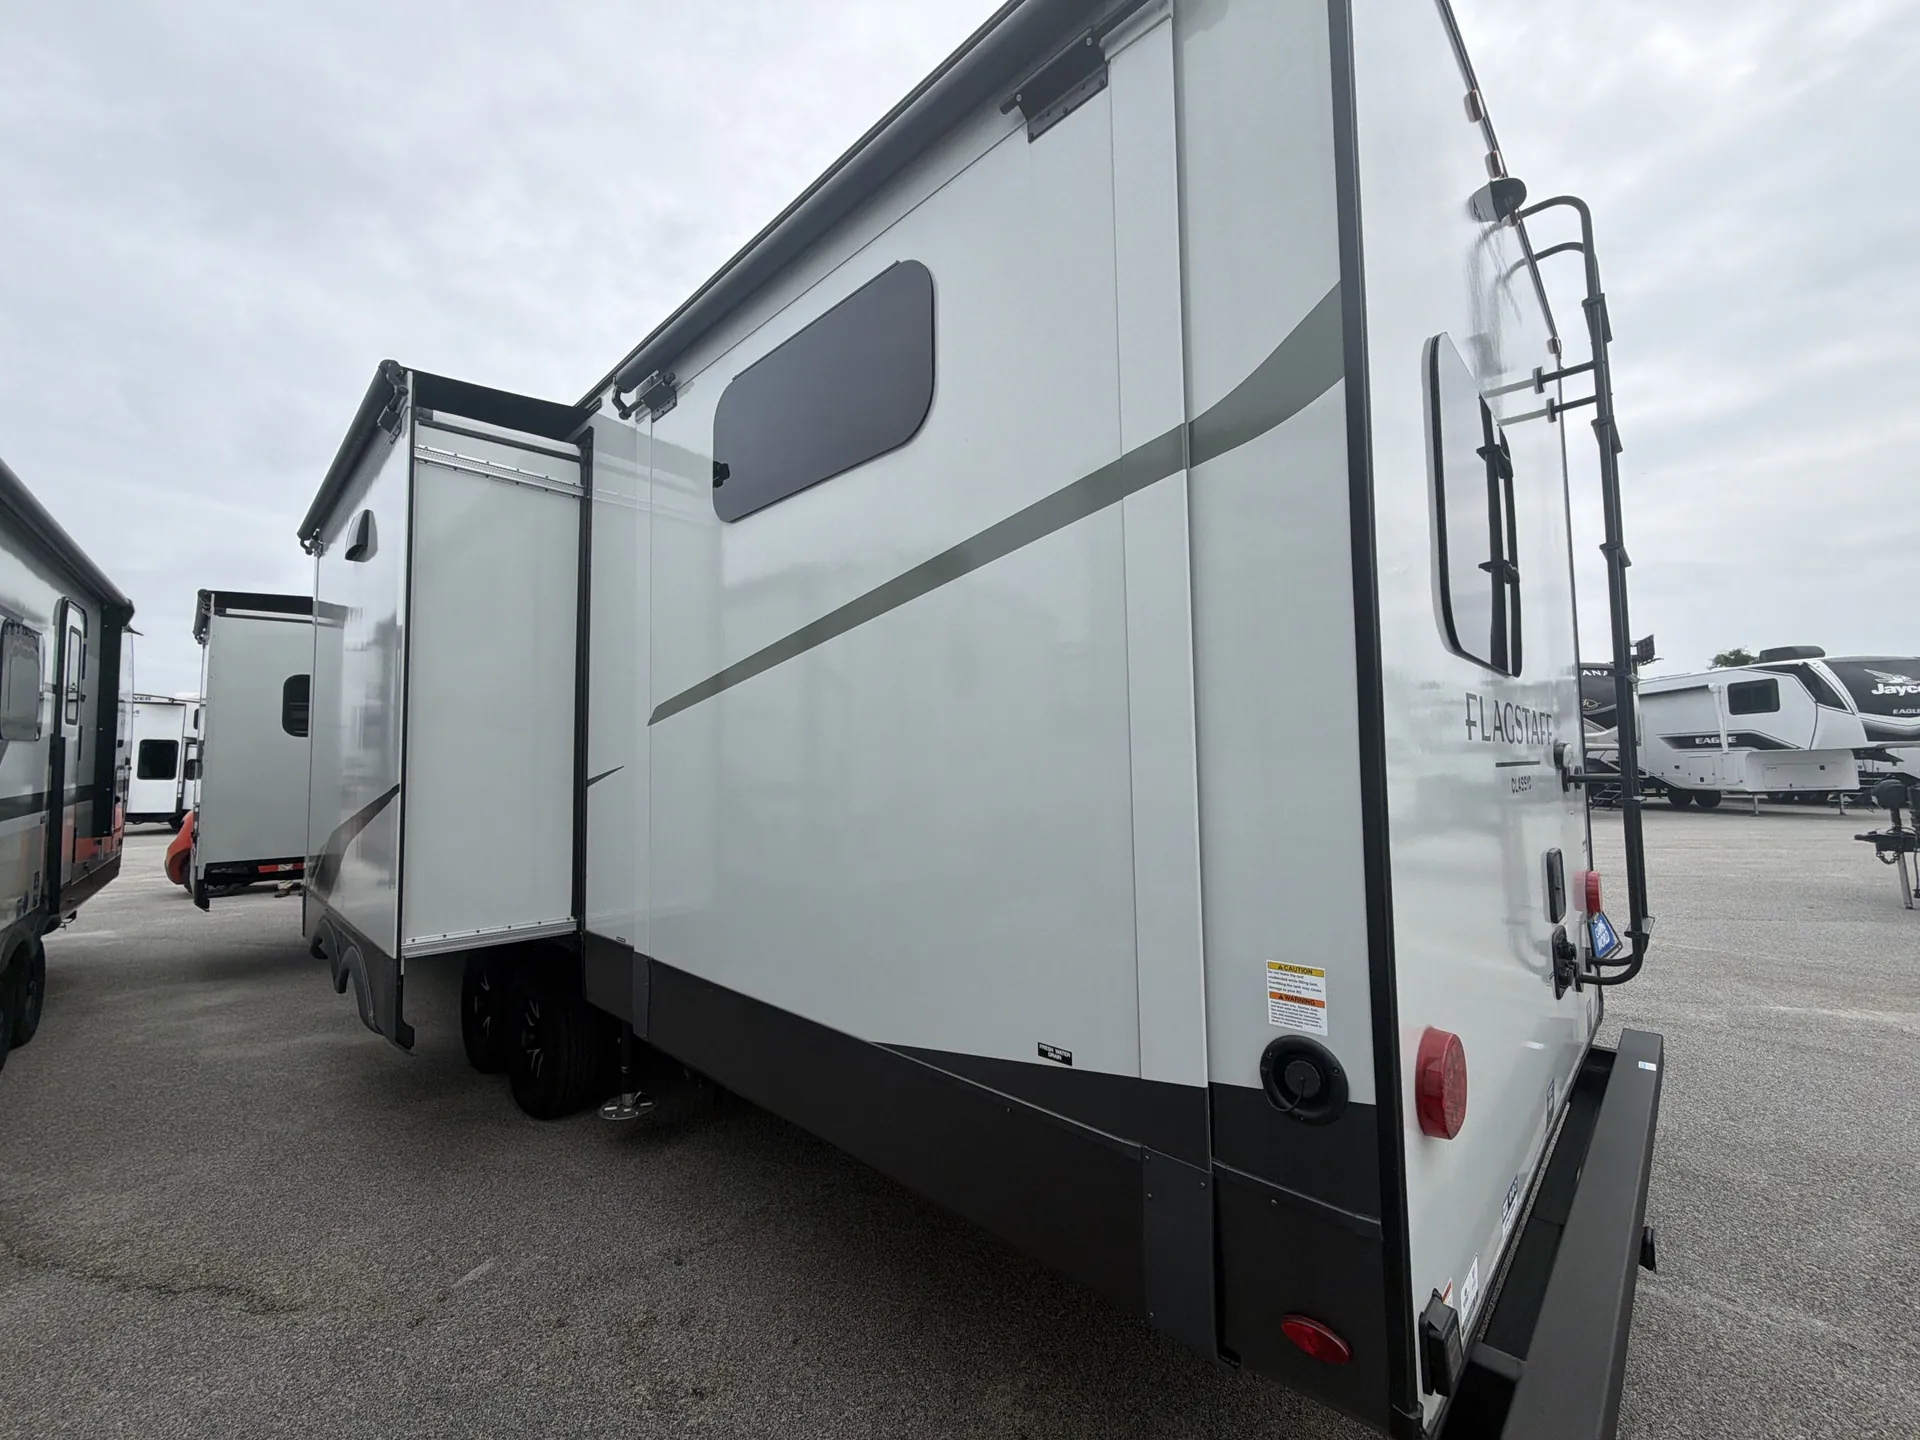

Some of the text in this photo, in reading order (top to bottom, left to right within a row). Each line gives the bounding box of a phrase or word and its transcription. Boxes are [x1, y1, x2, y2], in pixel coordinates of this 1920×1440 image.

[1871, 683, 1920, 696] Jayc
[1465, 692, 1552, 746] FLAGSTAFF
[1695, 736, 1737, 744] EAGE
[1511, 775, 1532, 793] CLASSIC
[1284, 965, 1312, 975] CAUTION
[1285, 995, 1316, 1005] WARNING
[1039, 1044, 1071, 1058] FRESH WATER
[1047, 1052, 1062, 1061] DRAIN
